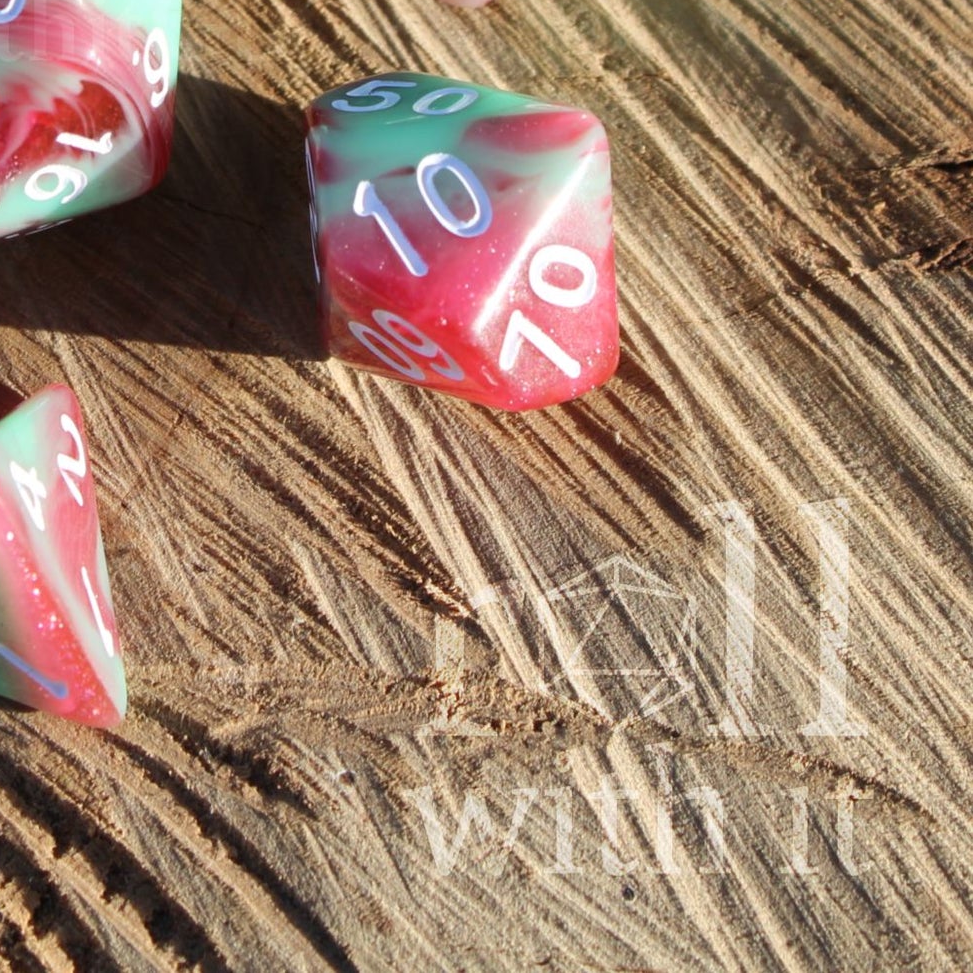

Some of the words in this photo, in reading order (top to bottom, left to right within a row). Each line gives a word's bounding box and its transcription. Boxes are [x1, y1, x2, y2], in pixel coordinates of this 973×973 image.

[331, 80, 479, 115] 50
[353, 153, 492, 277] 10
[499, 244, 597, 379] 70
[10, 461, 47, 532] 4
